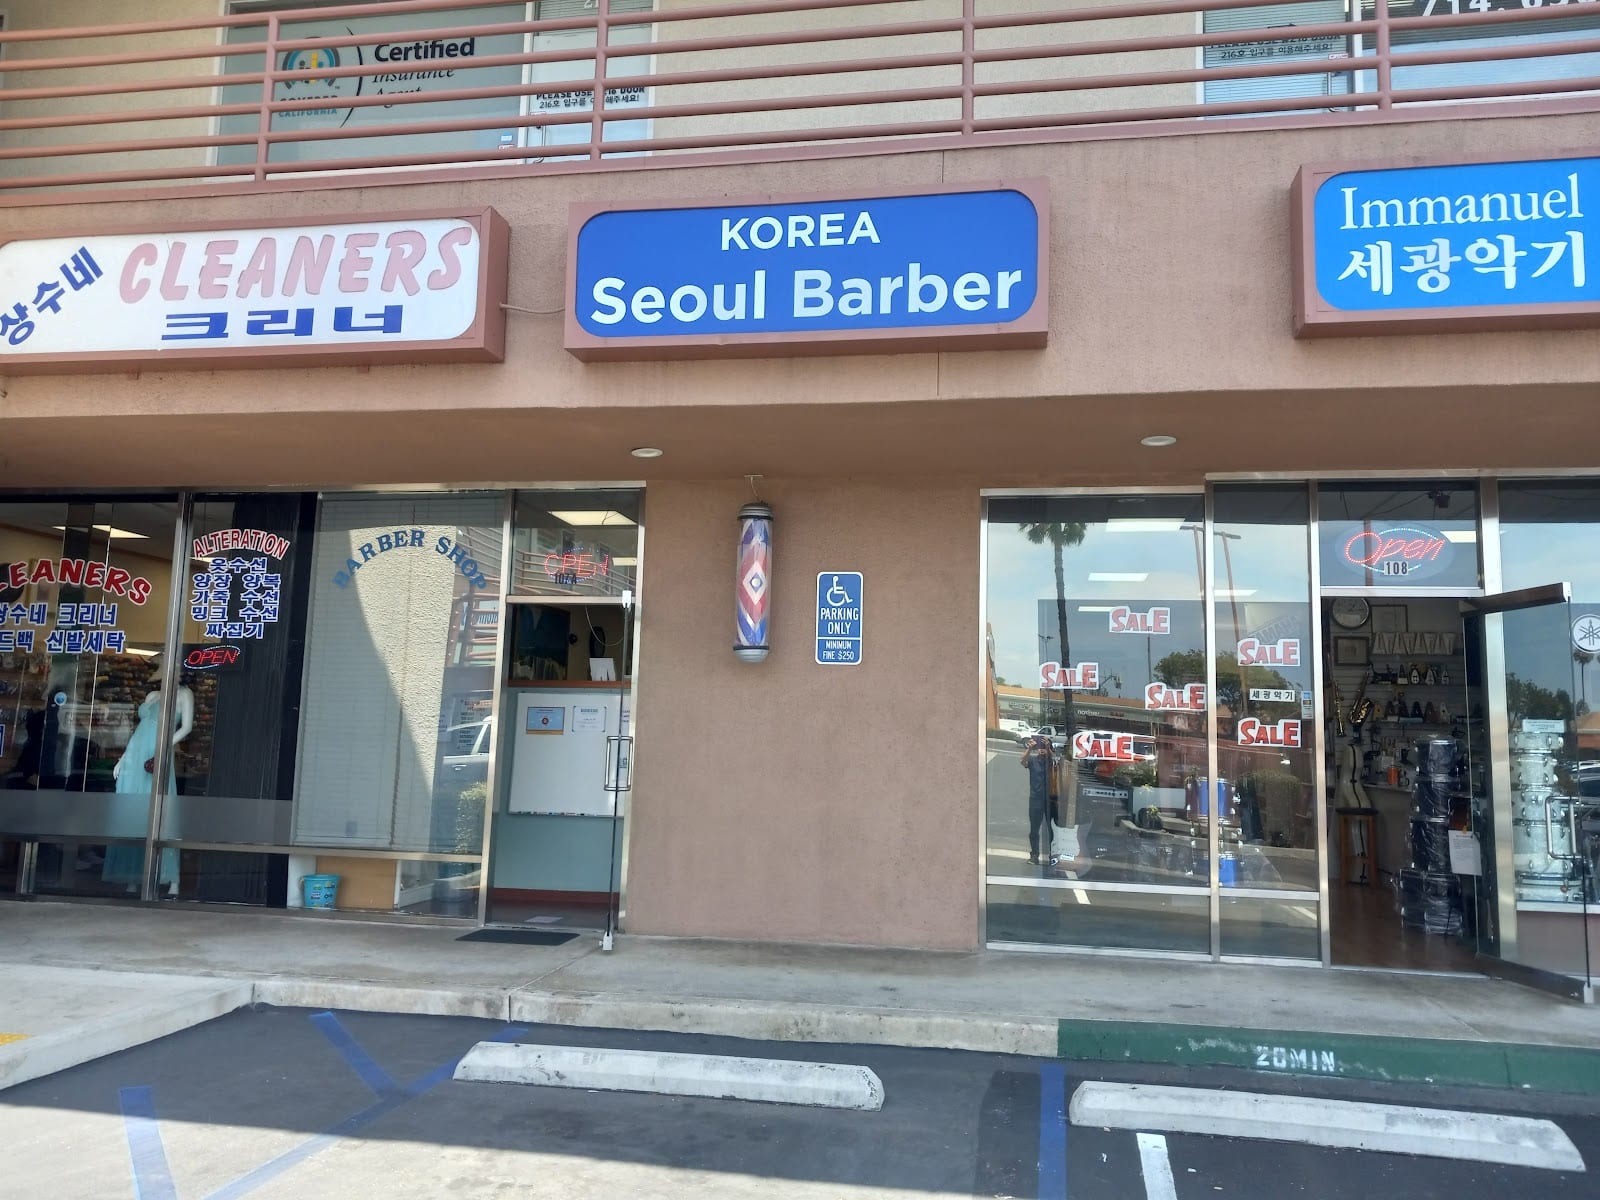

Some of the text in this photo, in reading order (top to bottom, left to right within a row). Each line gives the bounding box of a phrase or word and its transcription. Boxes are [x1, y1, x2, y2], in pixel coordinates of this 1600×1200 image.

[374, 38, 475, 62] Certified
[1340, 172, 1584, 230] Immanuel
[721, 211, 880, 251] KOREA
[118, 226, 473, 305] CLEANERS
[1337, 230, 1586, 296] 세광악기
[0, 246, 103, 345] 상수네
[590, 262, 1022, 325] Seoul Barber
[161, 304, 404, 341] 크리너
[193, 529, 290, 560] ALTERATION
[1345, 531, 1446, 566] Open
[209, 557, 267, 573] 옷수선
[332, 529, 488, 591] BARBER SHOP
[1386, 561, 1408, 575] 108
[0, 558, 152, 606] EANERS
[193, 574, 281, 590] 양장 양복
[191, 589, 280, 606] 가죽 수선
[57, 603, 118, 627] 크리너
[191, 606, 278, 622] 밍크 수선
[820, 608, 859, 621] PARKING
[1111, 607, 1169, 633] SALE
[205, 622, 264, 639] 짜집기
[827, 622, 852, 635] ONLY
[46, 630, 126, 655] 신발세탁
[822, 650, 855, 660] FINE $250
[825, 640, 852, 650] MINIMUM
[1239, 640, 1299, 666] SALE
[186, 649, 239, 666] OPEN
[1040, 664, 1098, 689] SALE
[1147, 684, 1206, 710] SALE
[1251, 690, 1293, 701] 세광악기
[1075, 733, 1133, 760] SALE
[1239, 721, 1300, 747] SALE
